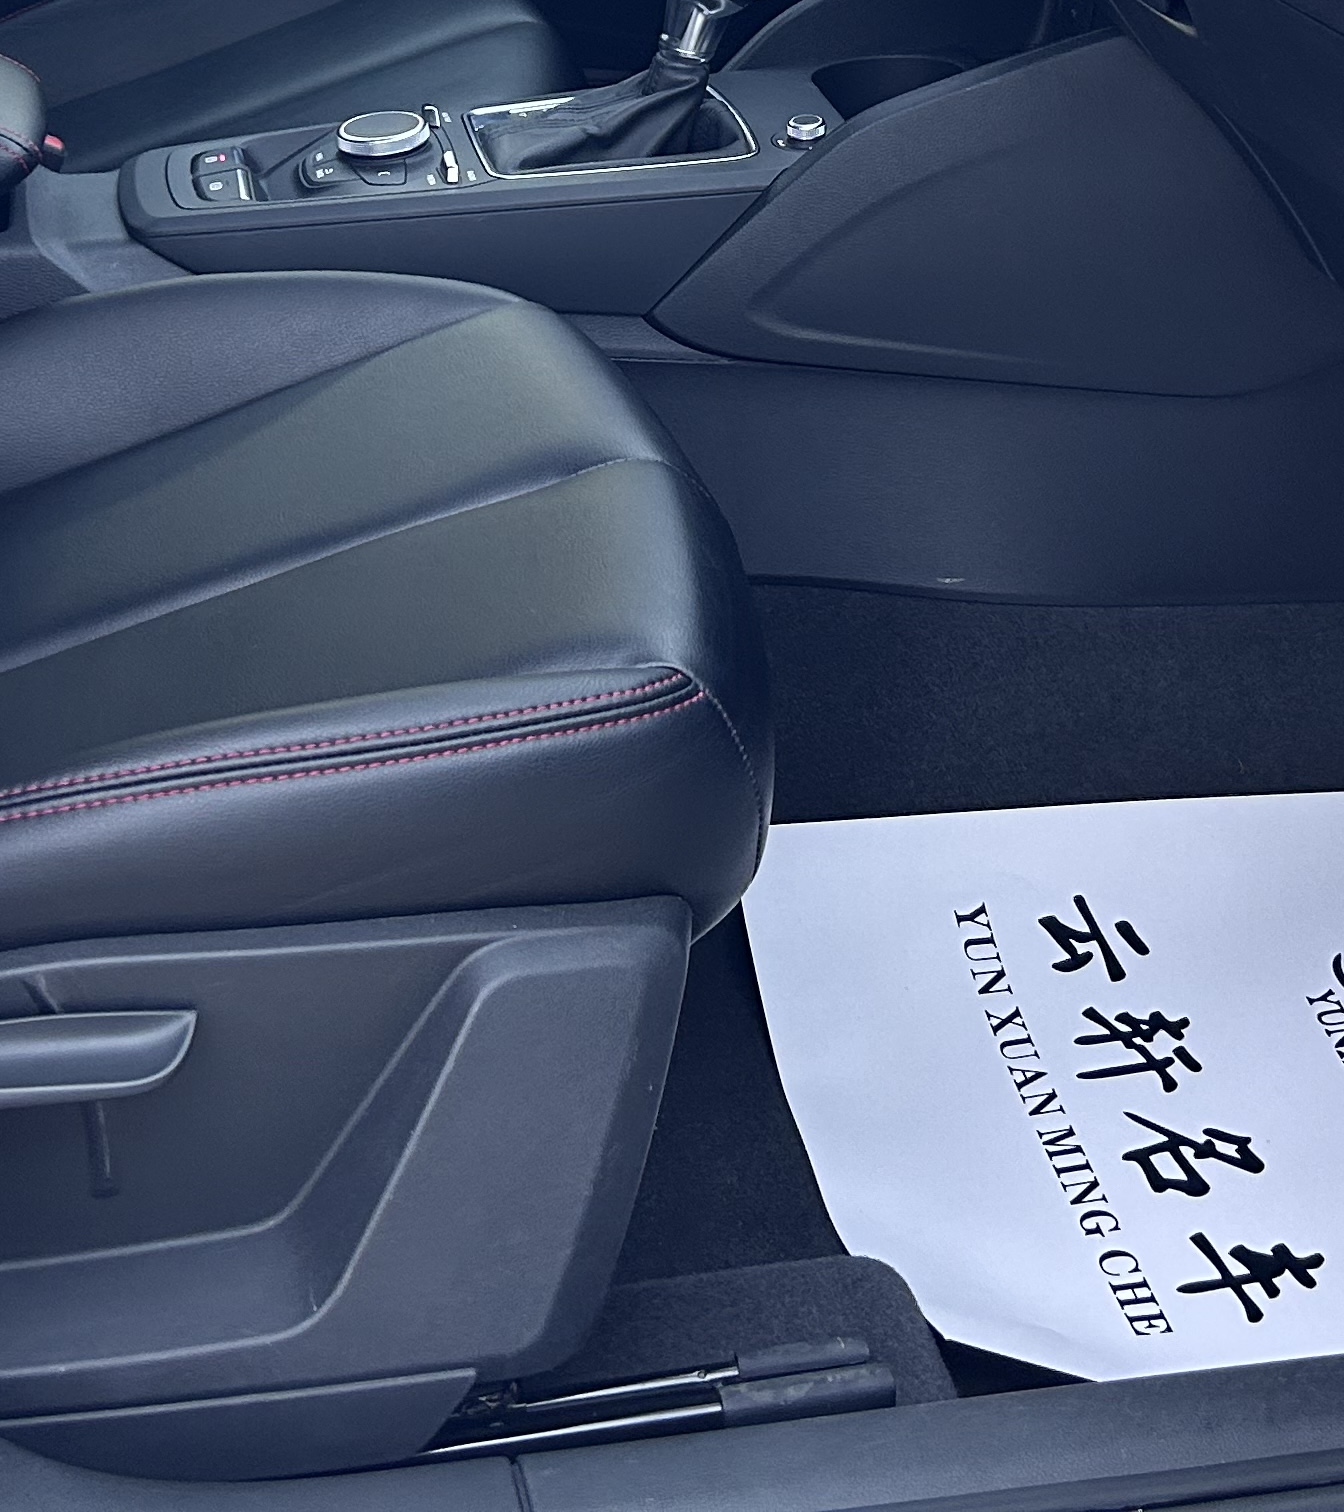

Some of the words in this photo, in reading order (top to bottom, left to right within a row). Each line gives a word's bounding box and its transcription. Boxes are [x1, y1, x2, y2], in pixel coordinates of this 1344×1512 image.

[953, 901, 1015, 996] YUN
[984, 1005, 1067, 1118] XUAN
[1036, 1123, 1122, 1239] MING
[1098, 1249, 1174, 1337] CHE
